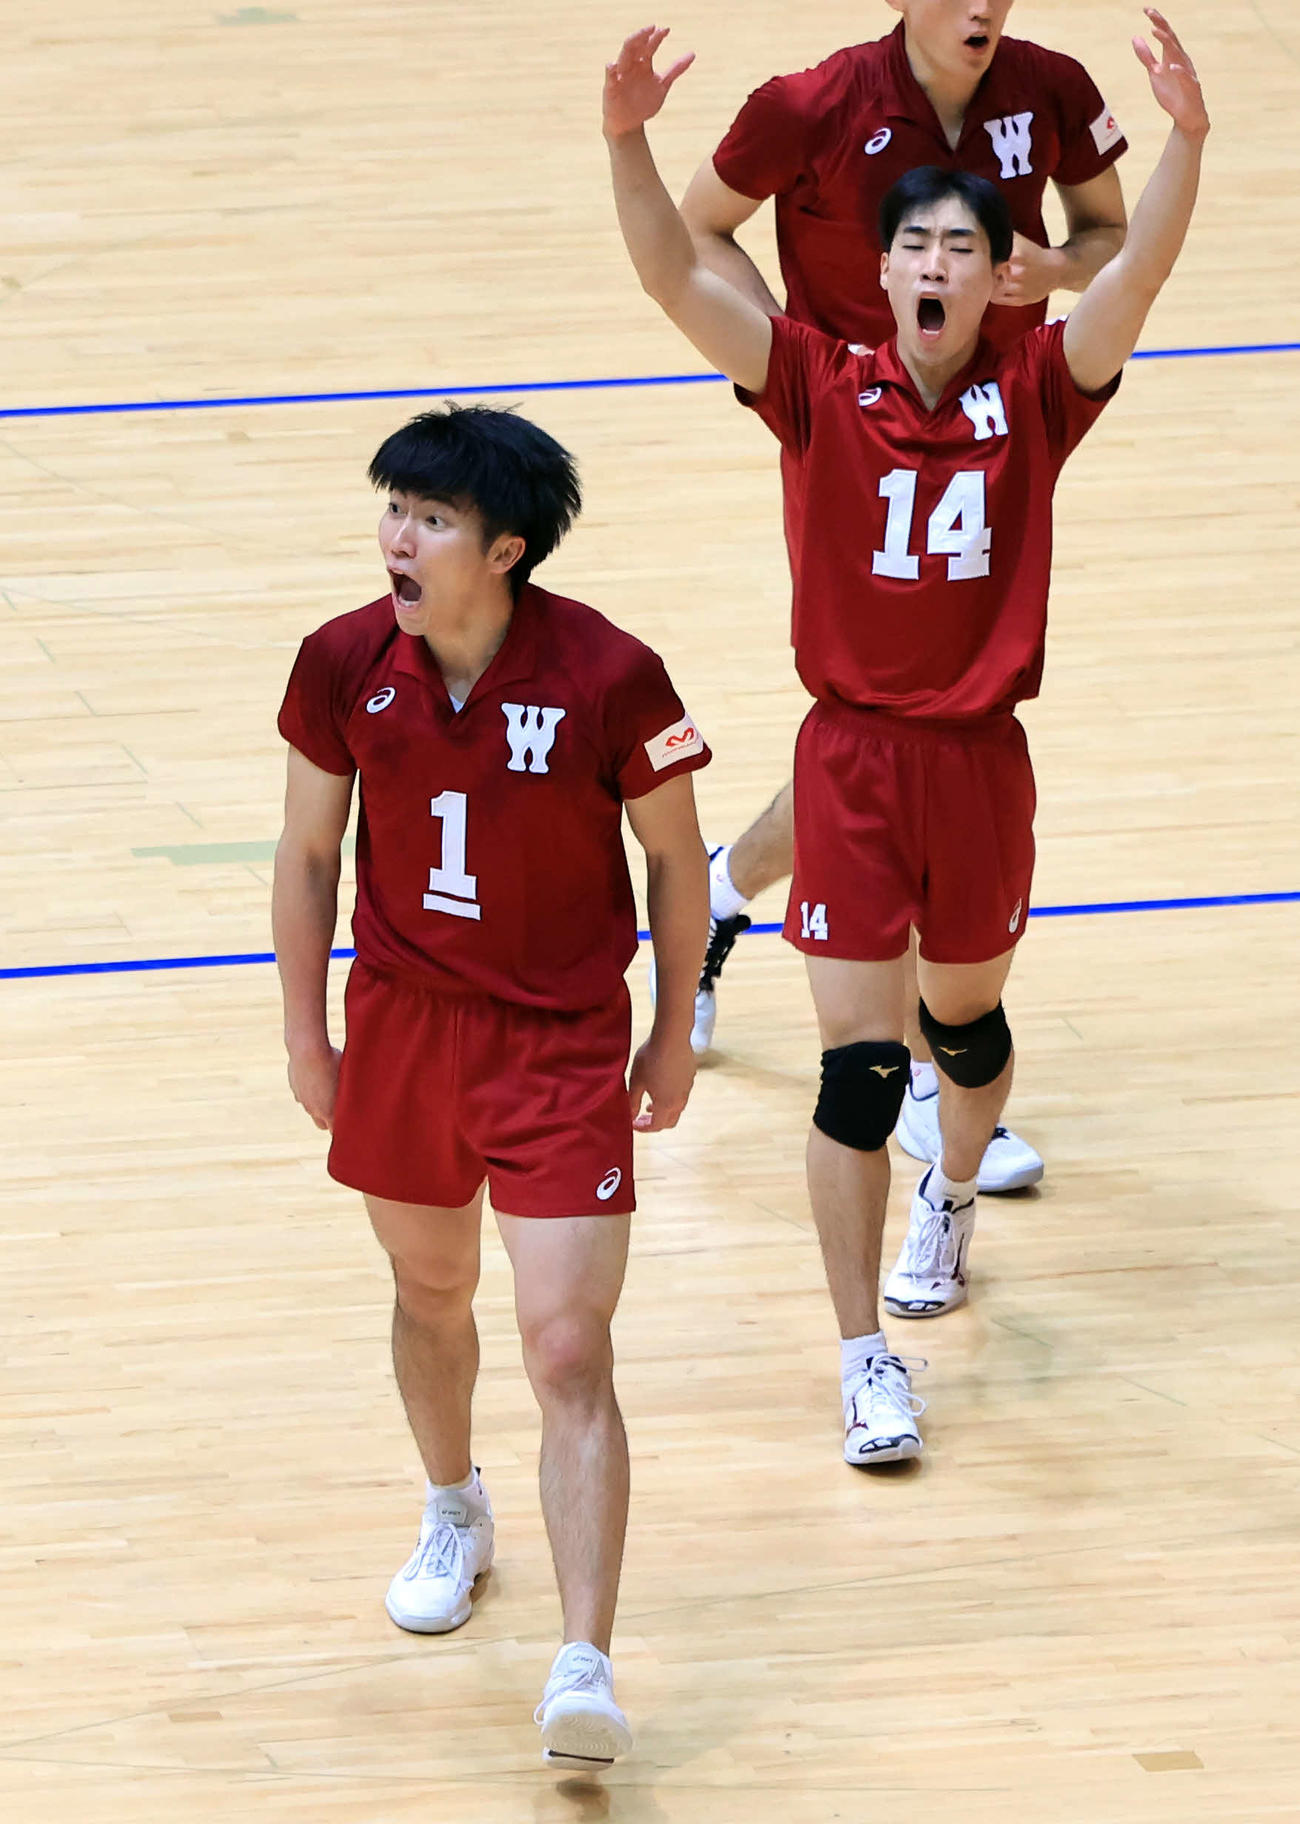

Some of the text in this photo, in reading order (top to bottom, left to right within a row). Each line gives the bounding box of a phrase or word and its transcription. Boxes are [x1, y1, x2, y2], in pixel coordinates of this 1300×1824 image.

[984, 112, 1033, 178] W
[959, 383, 1009, 440] W
[872, 469, 992, 581] 14
[501, 703, 566, 773] W
[429, 791, 477, 900] 1
[800, 901, 828, 940] 14
